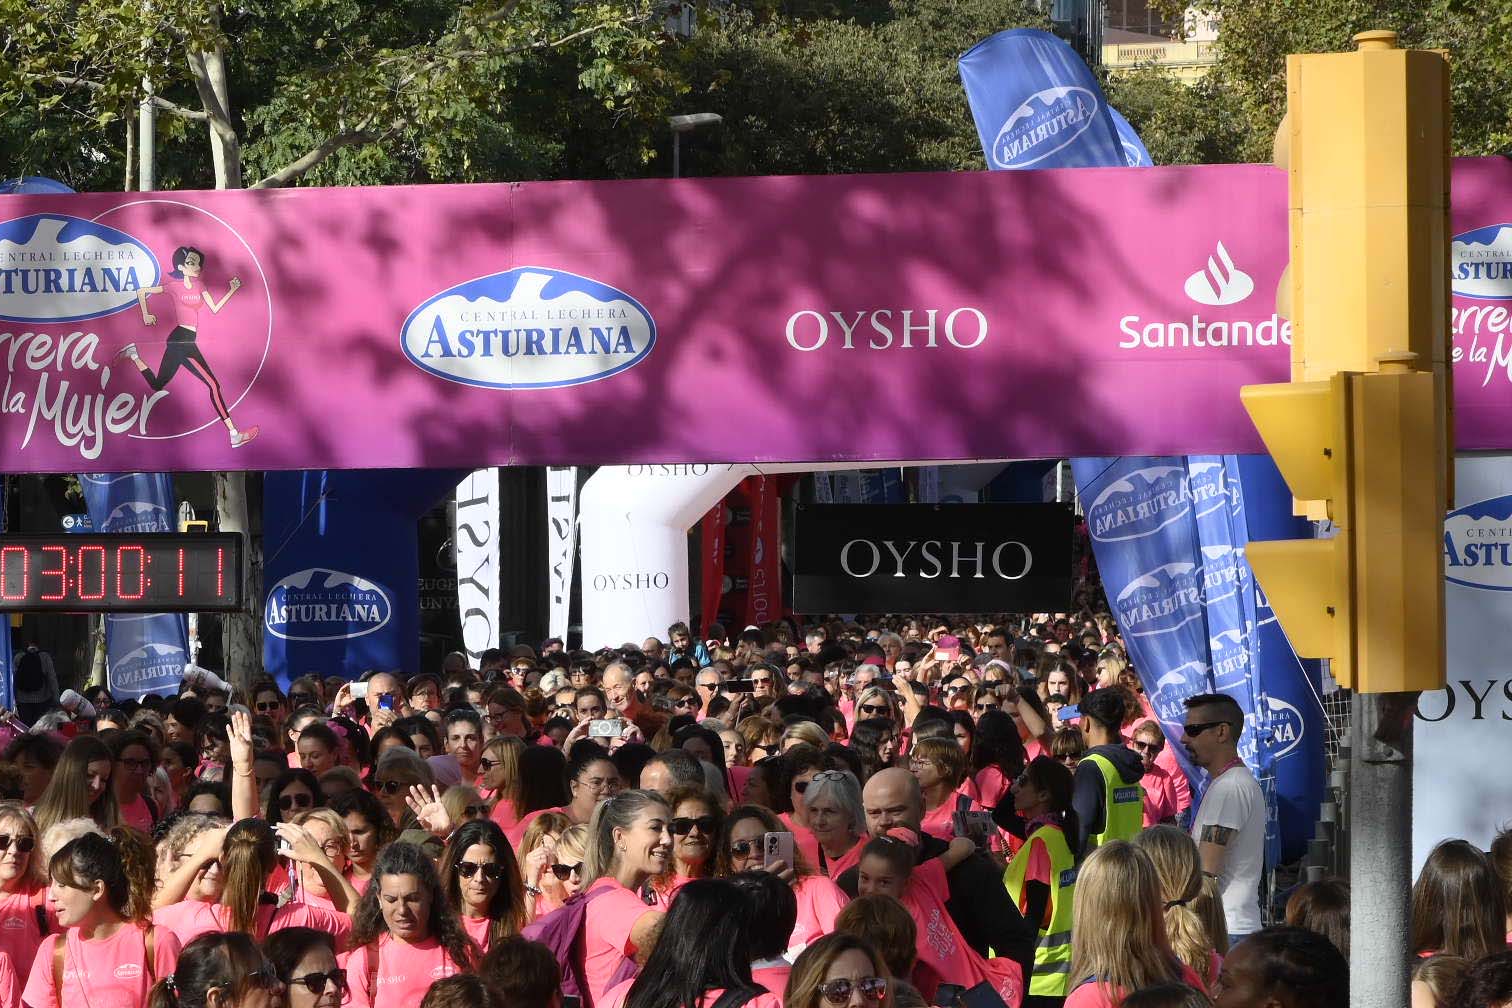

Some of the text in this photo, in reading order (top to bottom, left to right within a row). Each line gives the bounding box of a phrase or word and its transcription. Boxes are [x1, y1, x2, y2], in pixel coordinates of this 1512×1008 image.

[63, 249, 136, 261] LECHERA
[460, 308, 629, 323] CENTRAL LECHERA
[785, 307, 988, 352] OYSHO
[1119, 314, 1291, 349] Santande
[421, 314, 636, 359] ASTURIANA
[1469, 334, 1487, 363] la
[1, 374, 26, 415] la
[20, 367, 169, 460] Mujer
[0, 545, 224, 601] 03:00:11
[839, 538, 1035, 583] OYSHO
[593, 571, 670, 592] OYSHO
[269, 597, 381, 625] ASTURIANA
